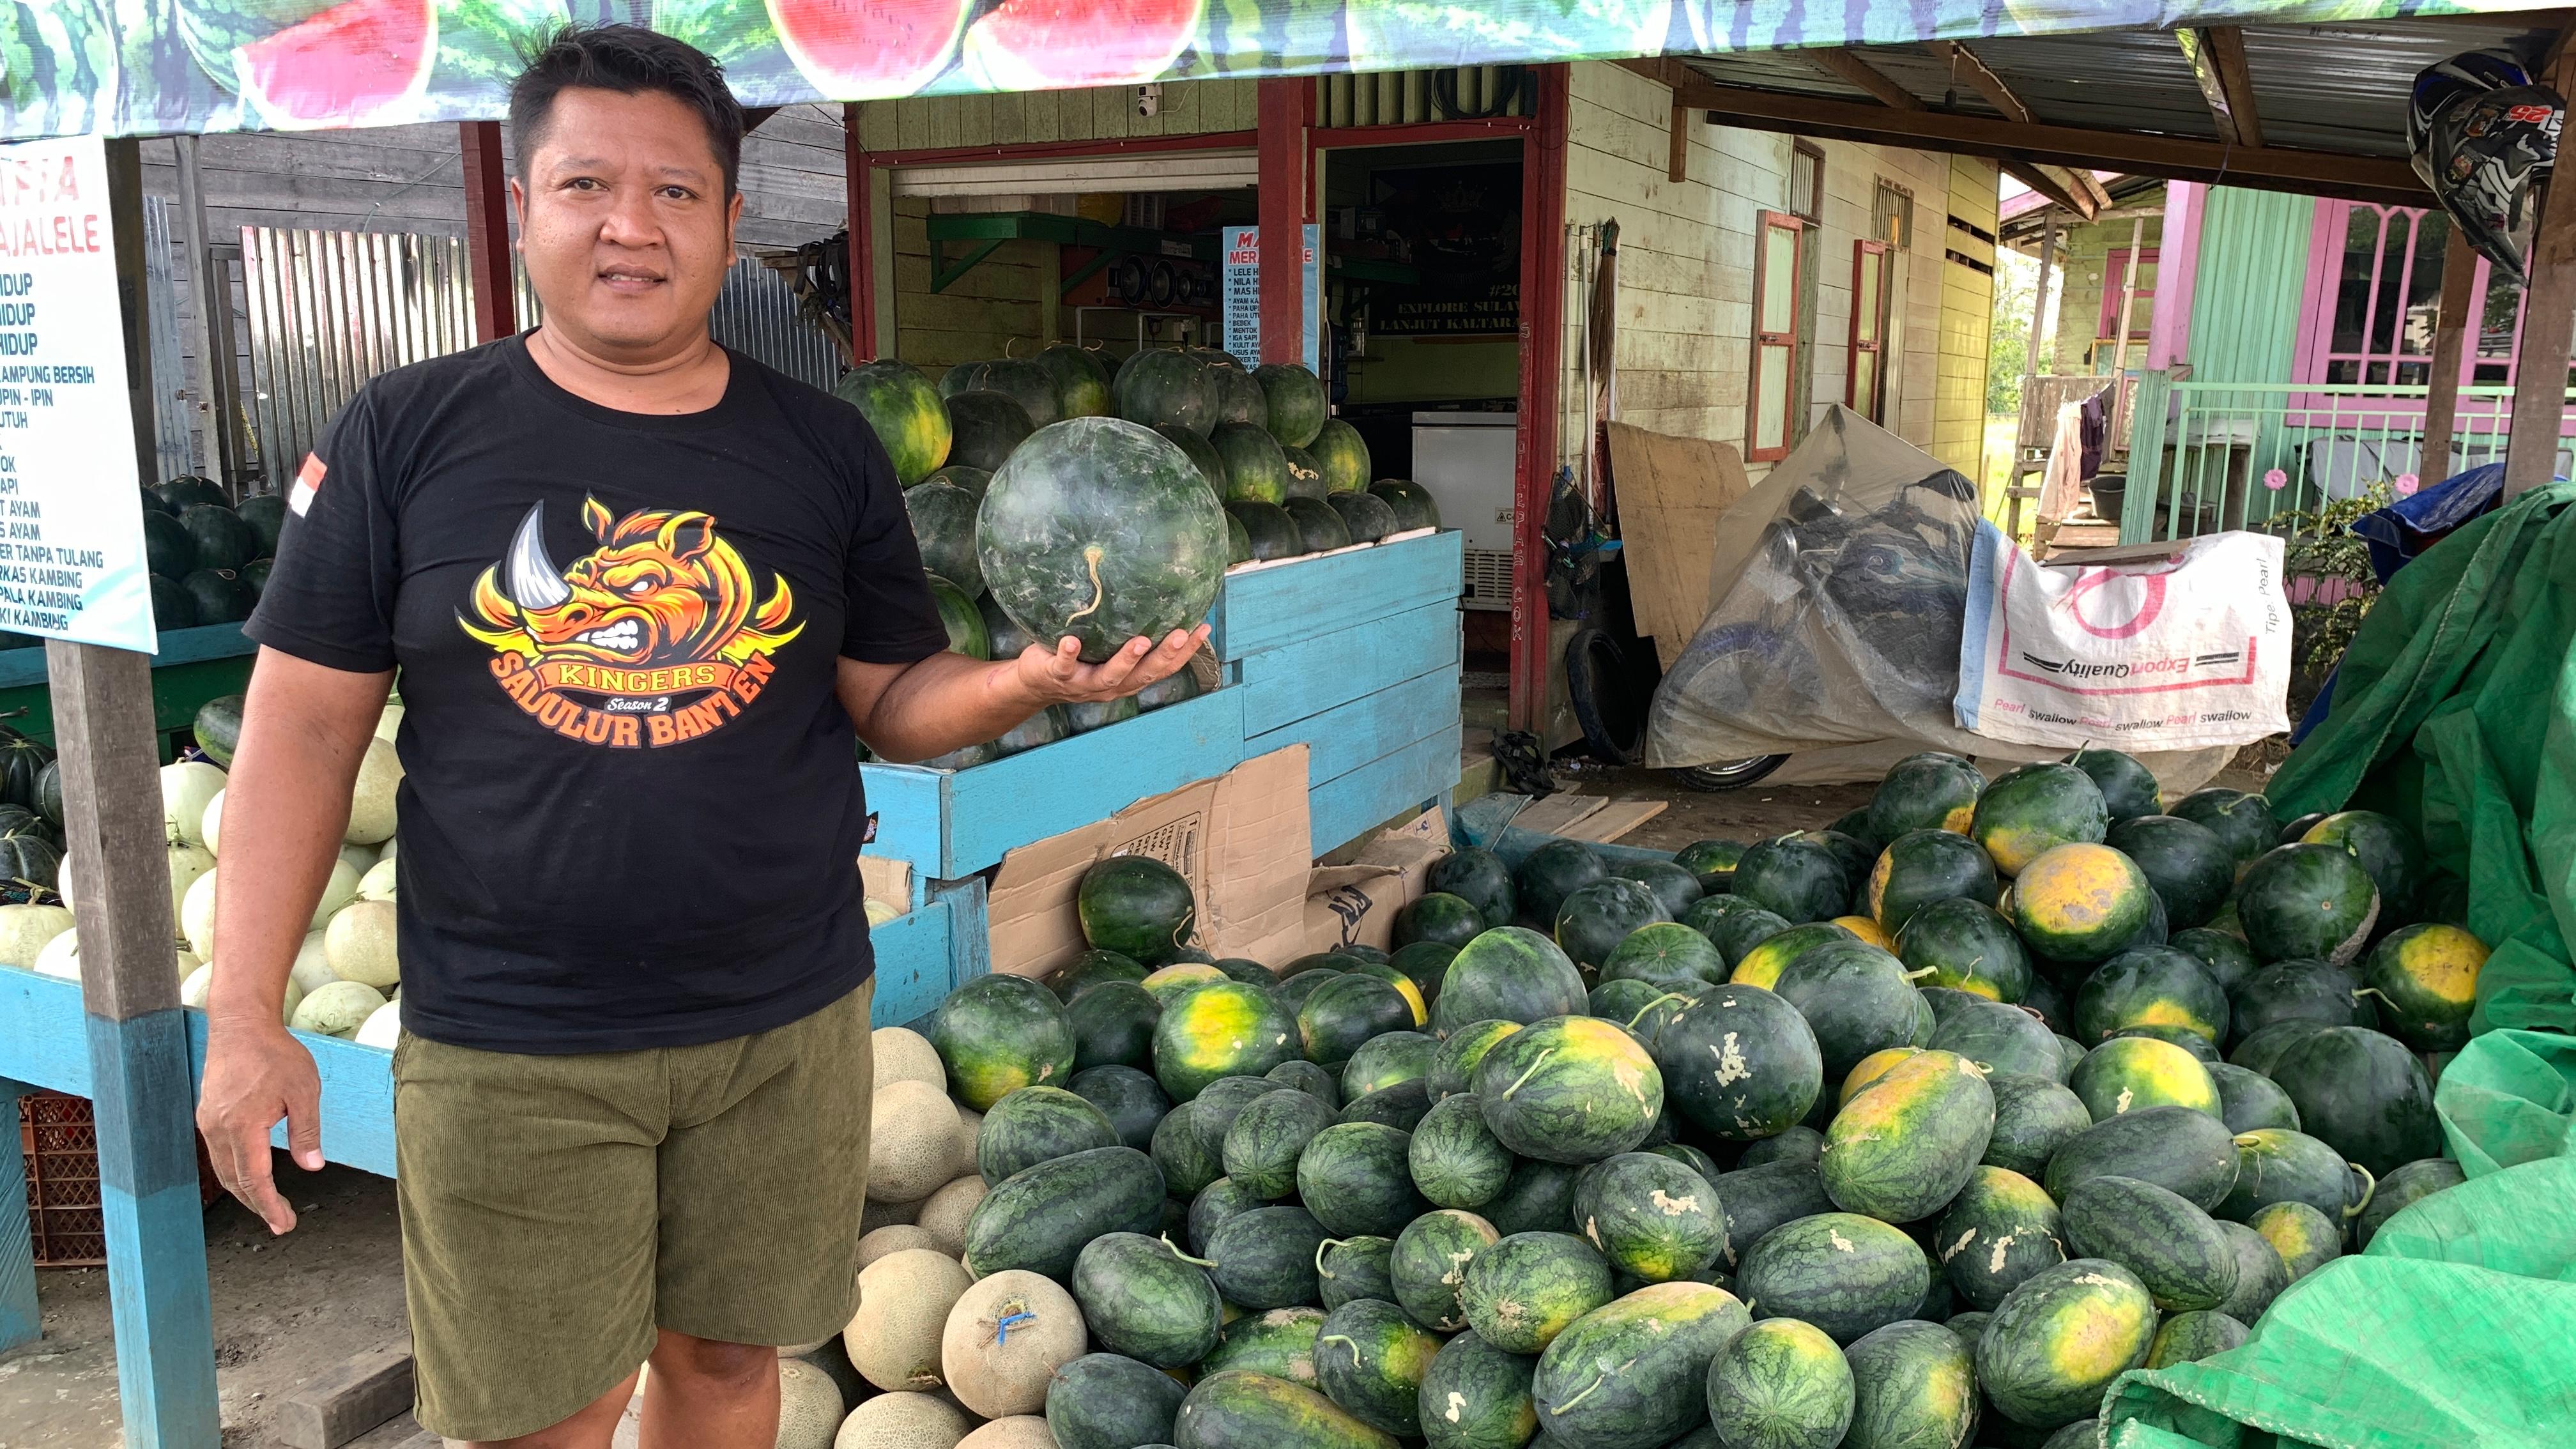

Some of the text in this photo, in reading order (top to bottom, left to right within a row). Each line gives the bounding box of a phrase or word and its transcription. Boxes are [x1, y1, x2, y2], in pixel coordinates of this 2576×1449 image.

[0, 303, 35, 326] IDUP
[1398, 302, 1468, 313] EXPLORE
[1380, 319, 1440, 330] LANJUT
[0, 365, 95, 383] AMPUNG BERSIH
[31, 388, 54, 406] IPIN
[10, 500, 42, 519] AYAM
[10, 522, 42, 541] AYAM
[15, 544, 54, 564] TANPA
[56, 548, 103, 569] TULANG
[29, 567, 82, 589] KAMBING
[2256, 558, 2271, 596] Pearl
[28, 589, 83, 611] KAMBING
[14, 609, 68, 631] KAMBING
[558, 664, 716, 692] KINGERS
[607, 697, 668, 712] Season 2
[1994, 699, 2026, 714] Pearl
[2028, 709, 2077, 725] swallow
[2115, 718, 2164, 732] swallow
[2166, 712, 2196, 726] Pearl
[2200, 709, 2251, 724] swallow
[1164, 825, 1175, 851] ITEM
